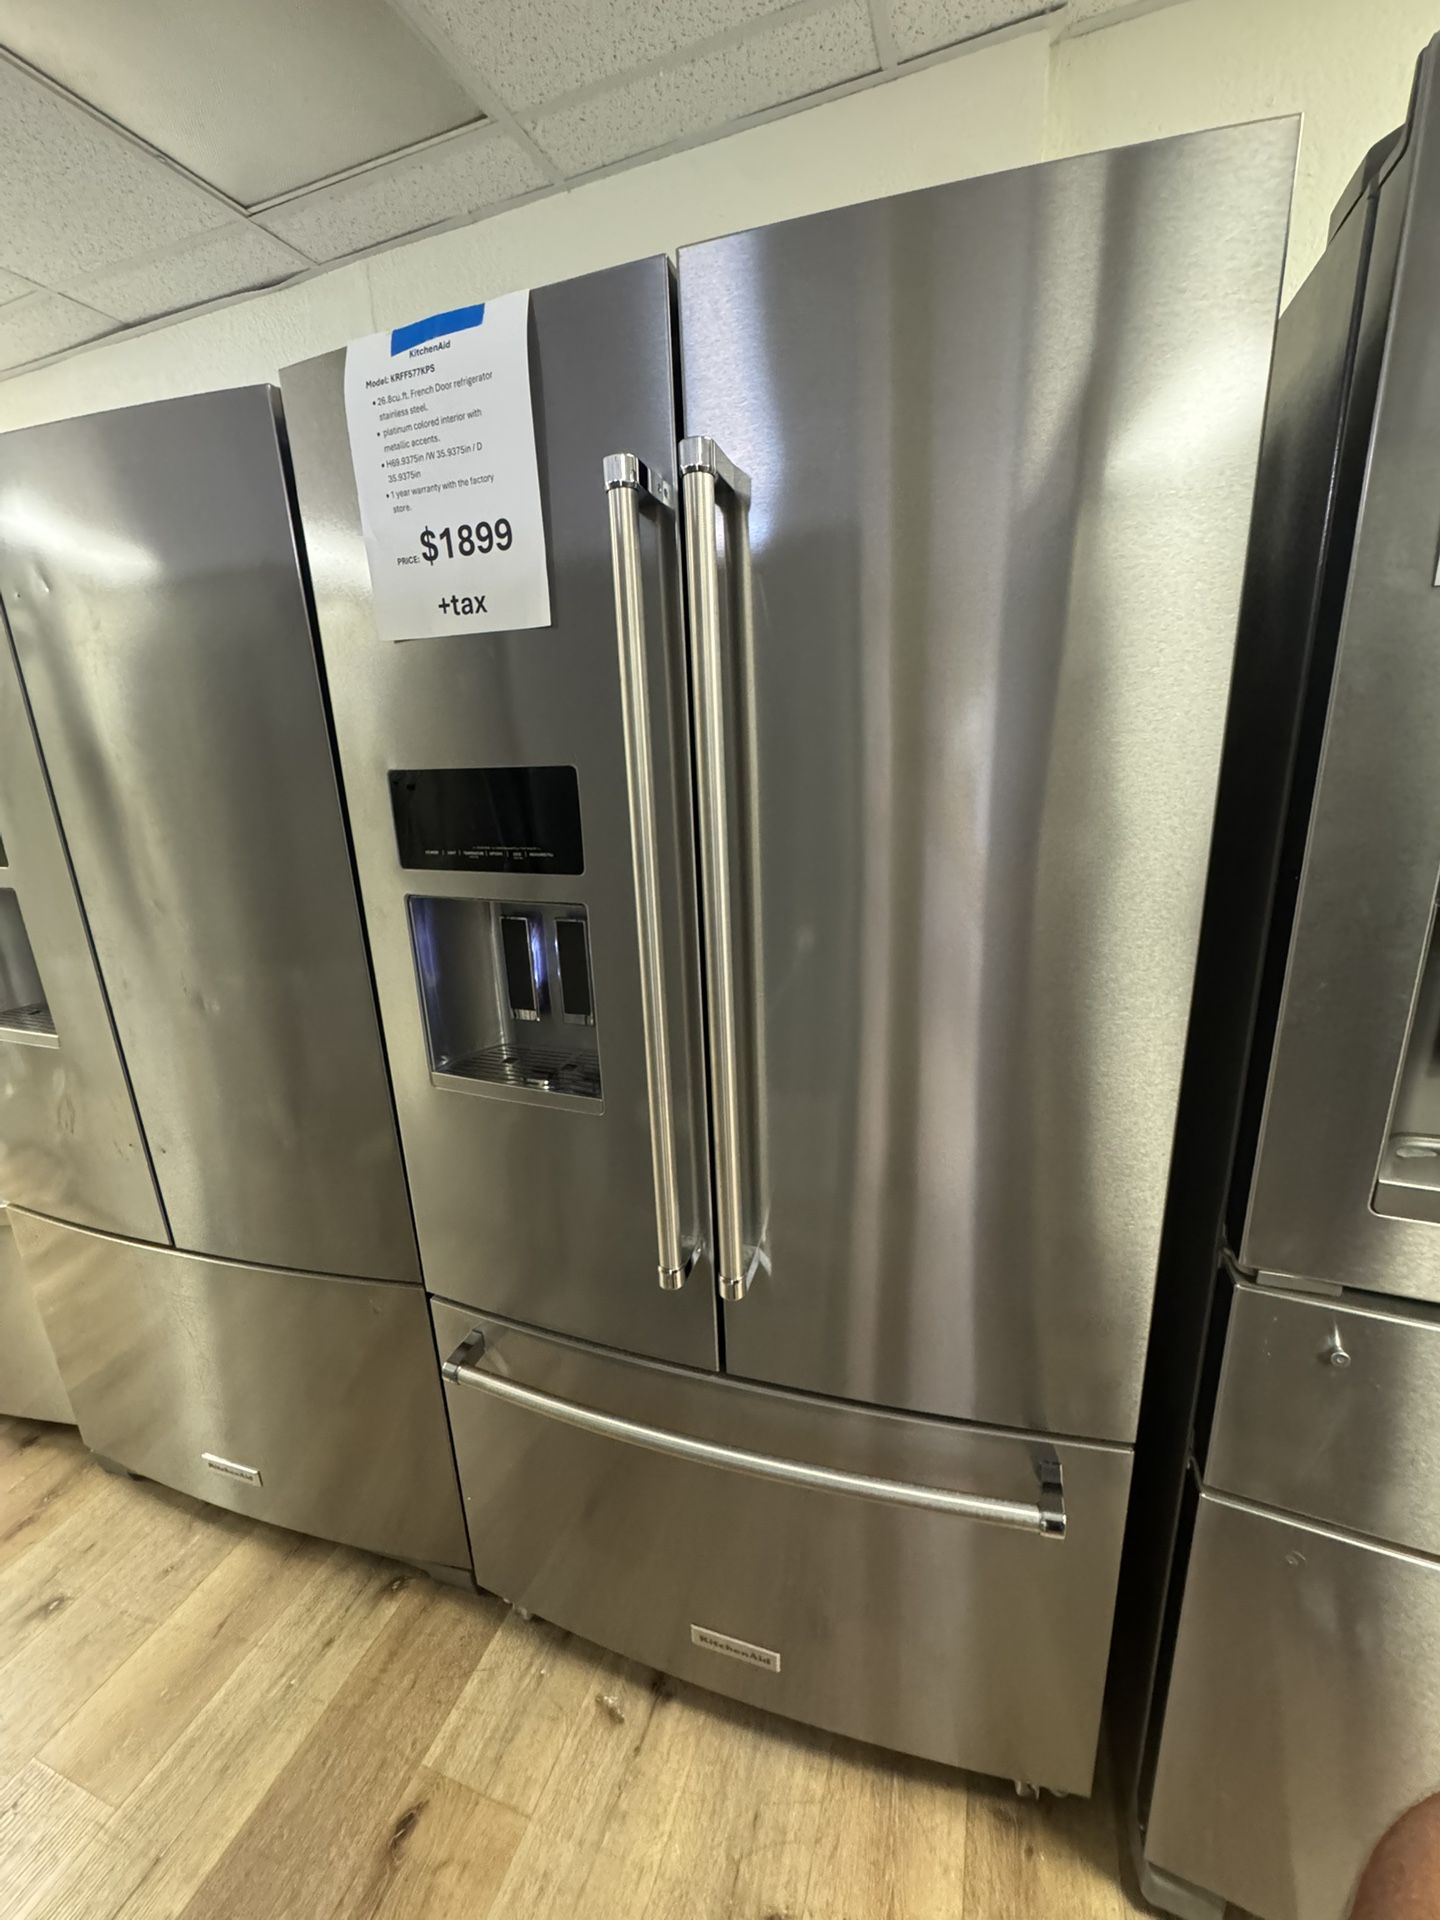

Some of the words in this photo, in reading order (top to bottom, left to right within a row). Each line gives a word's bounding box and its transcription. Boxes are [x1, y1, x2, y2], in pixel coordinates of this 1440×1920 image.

[409, 340, 451, 358] KitchenAid
[365, 379, 389, 389] Model:
[390, 364, 436, 383] KRFF577KPS
[410, 385, 434, 398] French
[435, 381, 452, 393] Door
[453, 371, 493, 388] refrigerator
[379, 408, 409, 421] stainless
[410, 403, 429, 415] steel.
[383, 424, 413, 438] platinum
[413, 417, 440, 431] colored
[440, 412, 466, 425] interior
[467, 408, 483, 419] with
[384, 440, 410, 453] metallic
[411, 435, 441, 447] accents.
[386, 454, 424, 468] H69.9375in
[436, 445, 471, 459] 35.9375in
[476, 442, 483, 451] D
[388, 470, 421, 483] 35.9375in
[390, 491, 395, 499] 1
[395, 488, 410, 500] year
[411, 483, 441, 496] warranty
[442, 480, 457, 490] with
[457, 478, 469, 488] the
[469, 473, 494, 487] factory
[393, 504, 412, 514] store.
[397, 555, 421, 566] PRICE:
[420, 517, 513, 566] $1899
[438, 594, 488, 616] +tax
